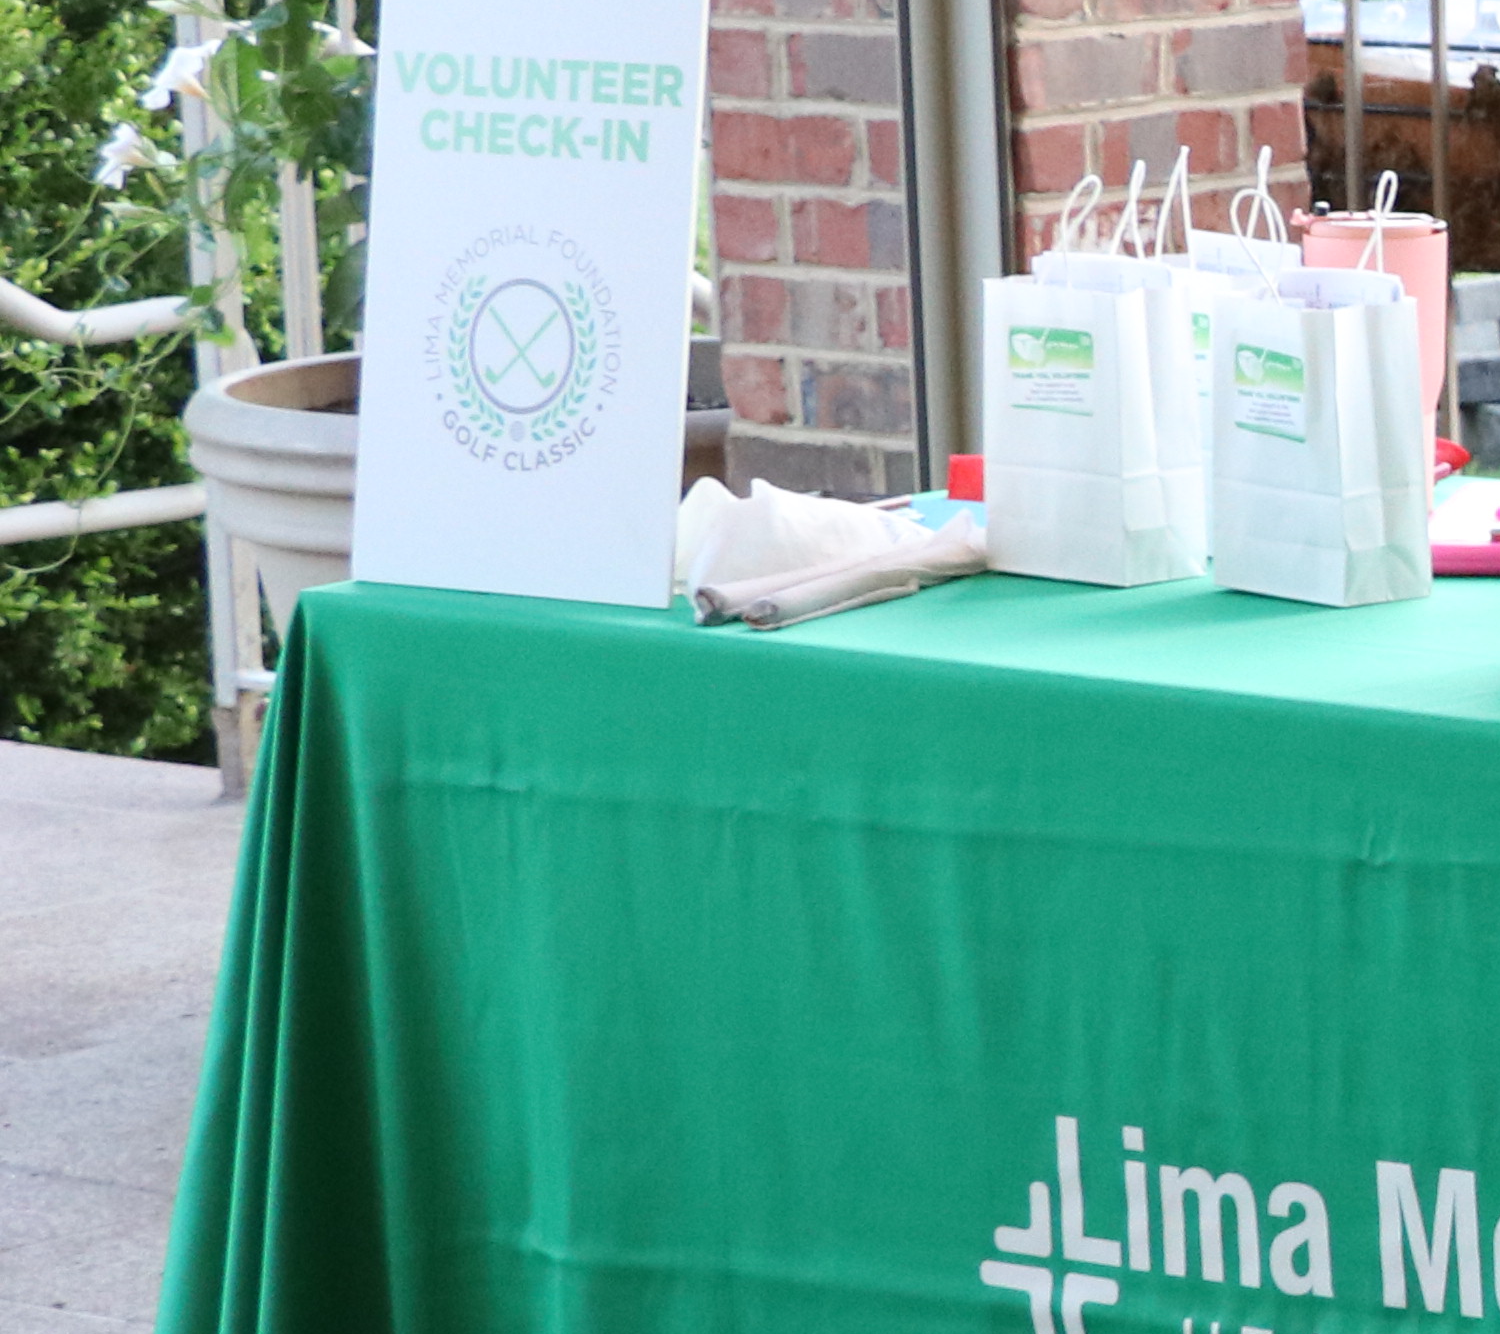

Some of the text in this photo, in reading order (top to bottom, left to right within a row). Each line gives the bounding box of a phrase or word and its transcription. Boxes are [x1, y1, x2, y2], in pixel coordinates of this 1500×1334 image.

[394, 50, 685, 108] VOLUNTEER
[420, 108, 652, 163] CHECK-IN
[424, 224, 621, 396] LIMA MEMORIAL FOUNDATION
[442, 410, 597, 472] GOLF CLASSIC
[1055, 1114, 1334, 1298] Lima
